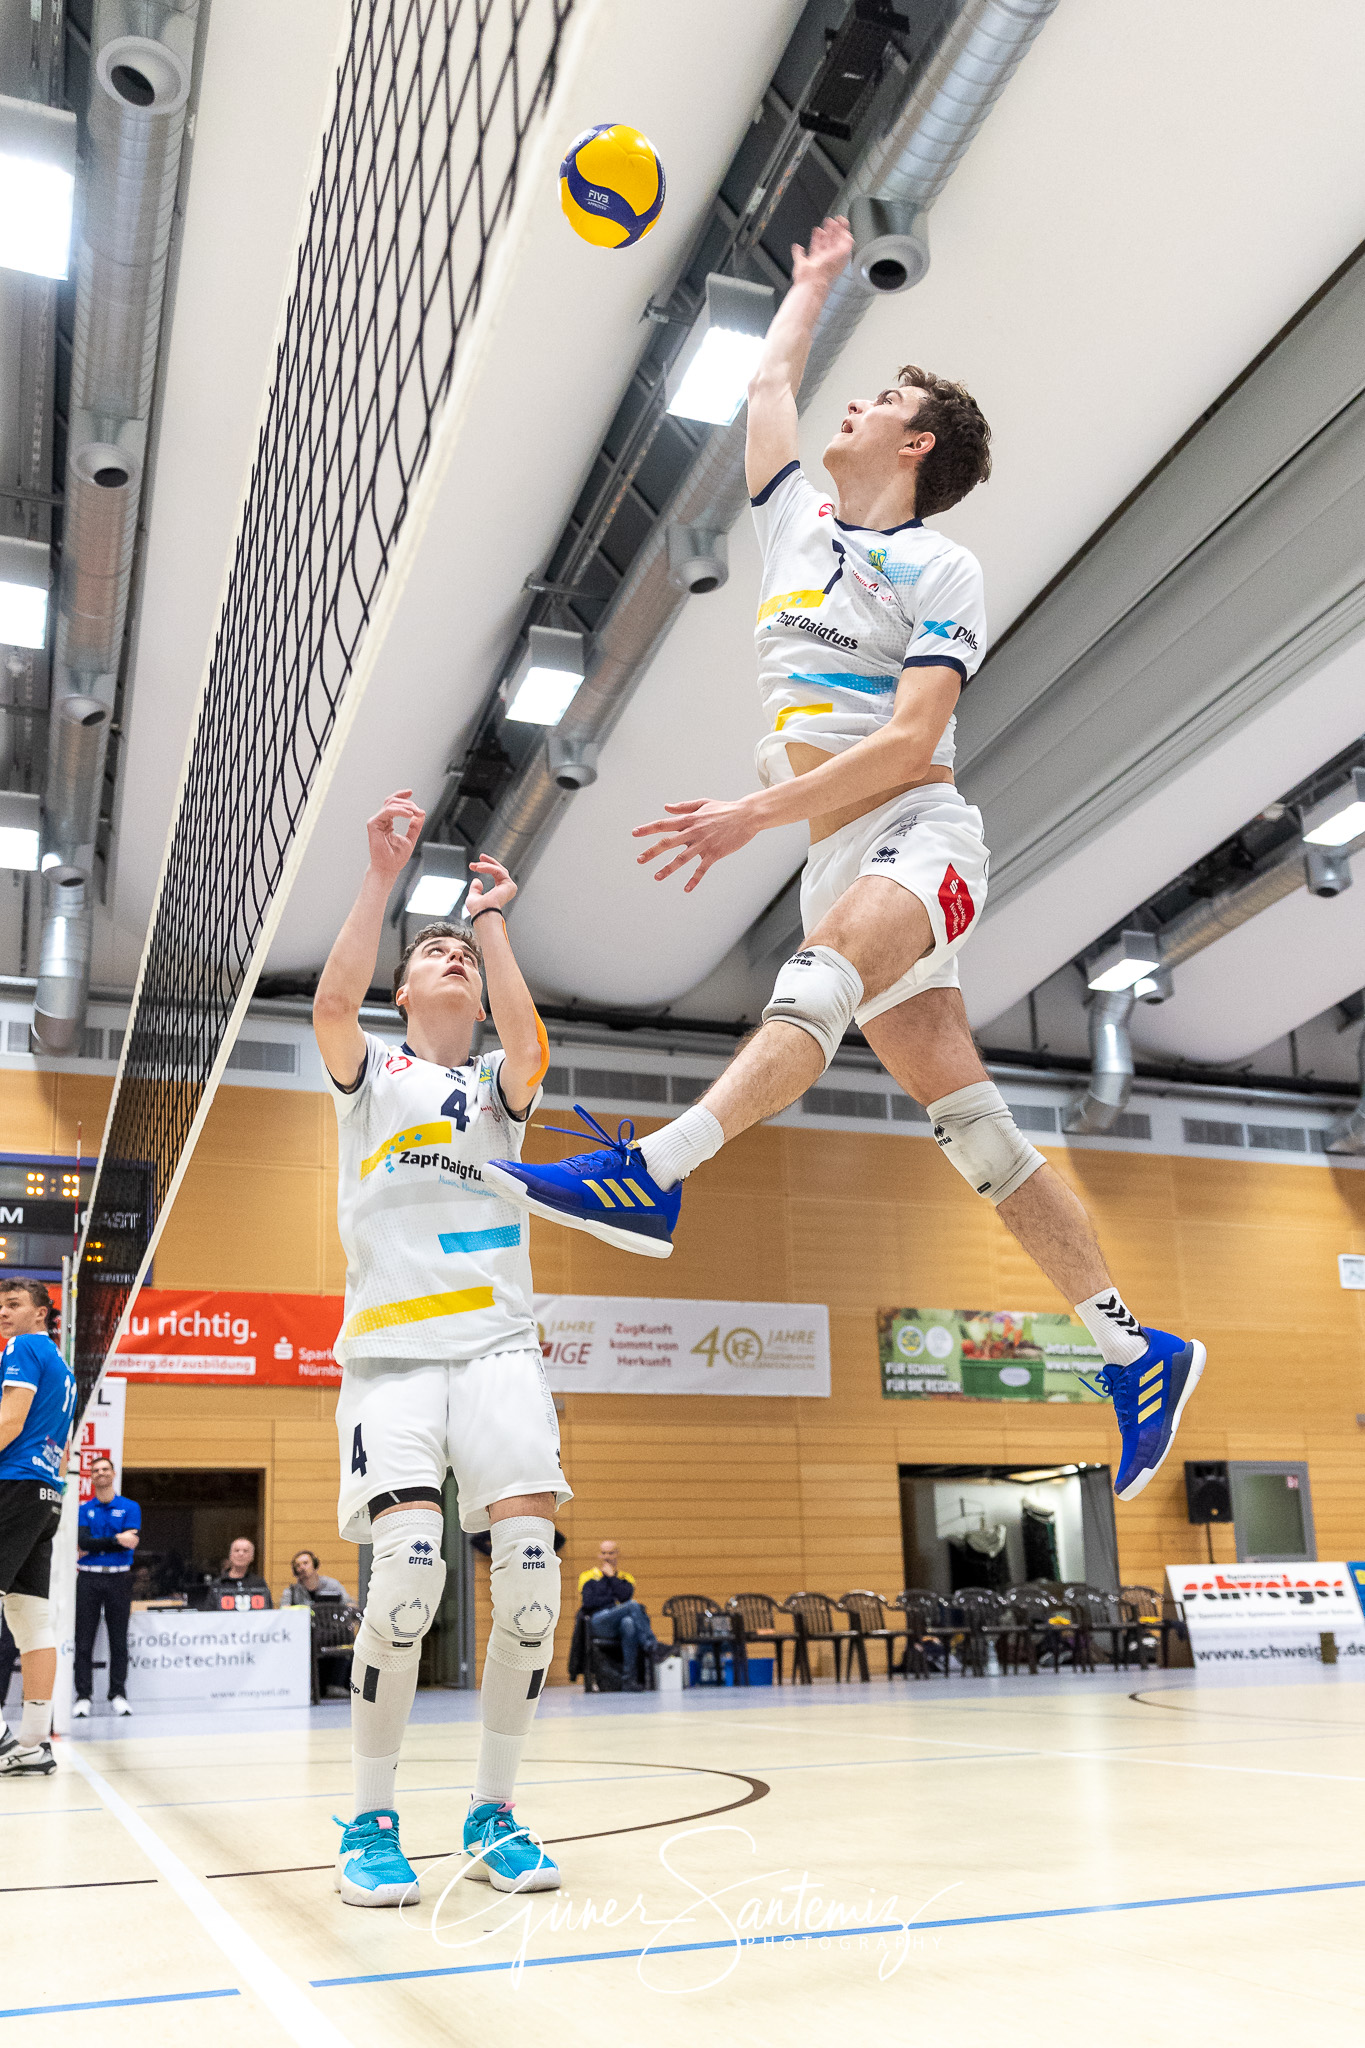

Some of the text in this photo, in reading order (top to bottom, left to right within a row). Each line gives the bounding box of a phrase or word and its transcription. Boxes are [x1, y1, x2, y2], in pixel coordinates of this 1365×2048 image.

[822, 539, 846, 594] 7
[776, 612, 803, 628] Zapf
[440, 1089, 470, 1132] 4
[399, 1151, 485, 1183] Zapf Daigfu
[158, 1310, 258, 1345] richtig.
[351, 1423, 368, 1478] 4
